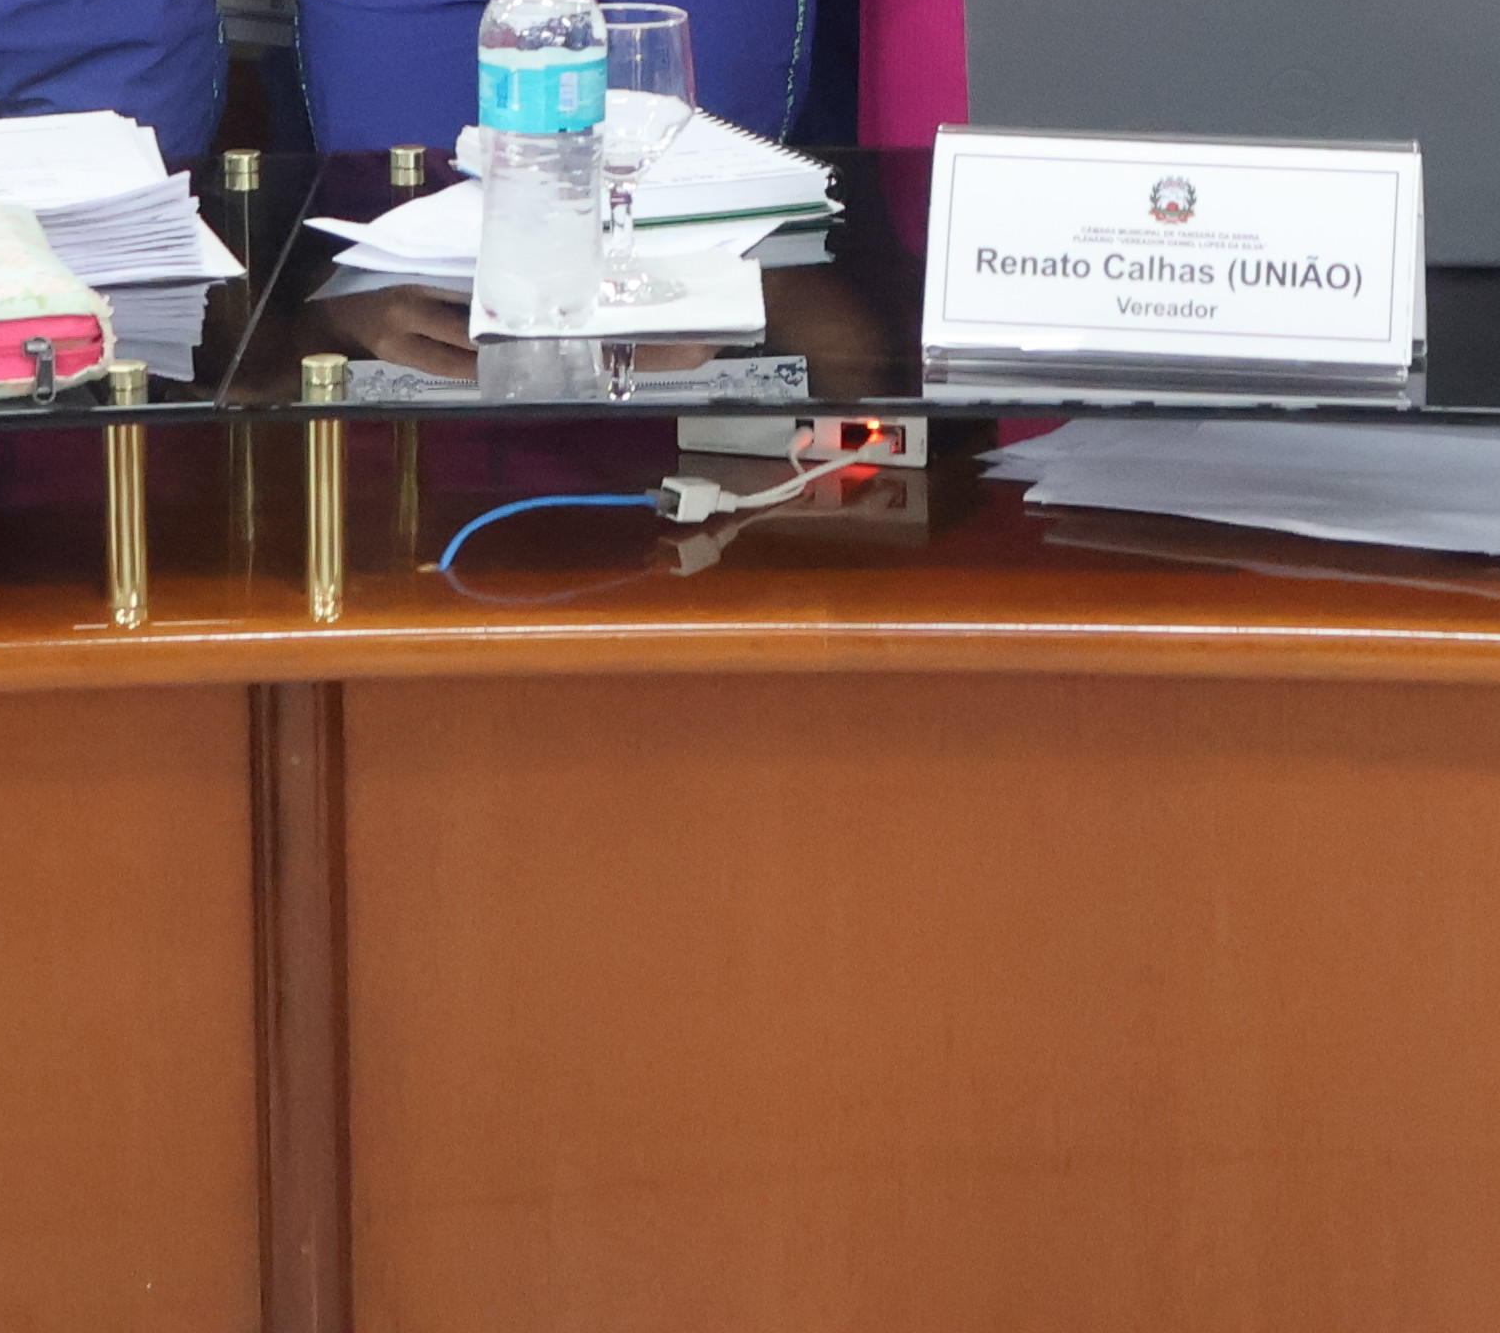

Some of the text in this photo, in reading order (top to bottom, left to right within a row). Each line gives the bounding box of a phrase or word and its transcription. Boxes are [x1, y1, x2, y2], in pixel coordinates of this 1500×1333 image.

[974, 246, 1364, 295] Renato Calhas (UNIÃO)
[1115, 295, 1220, 321] Vereador
